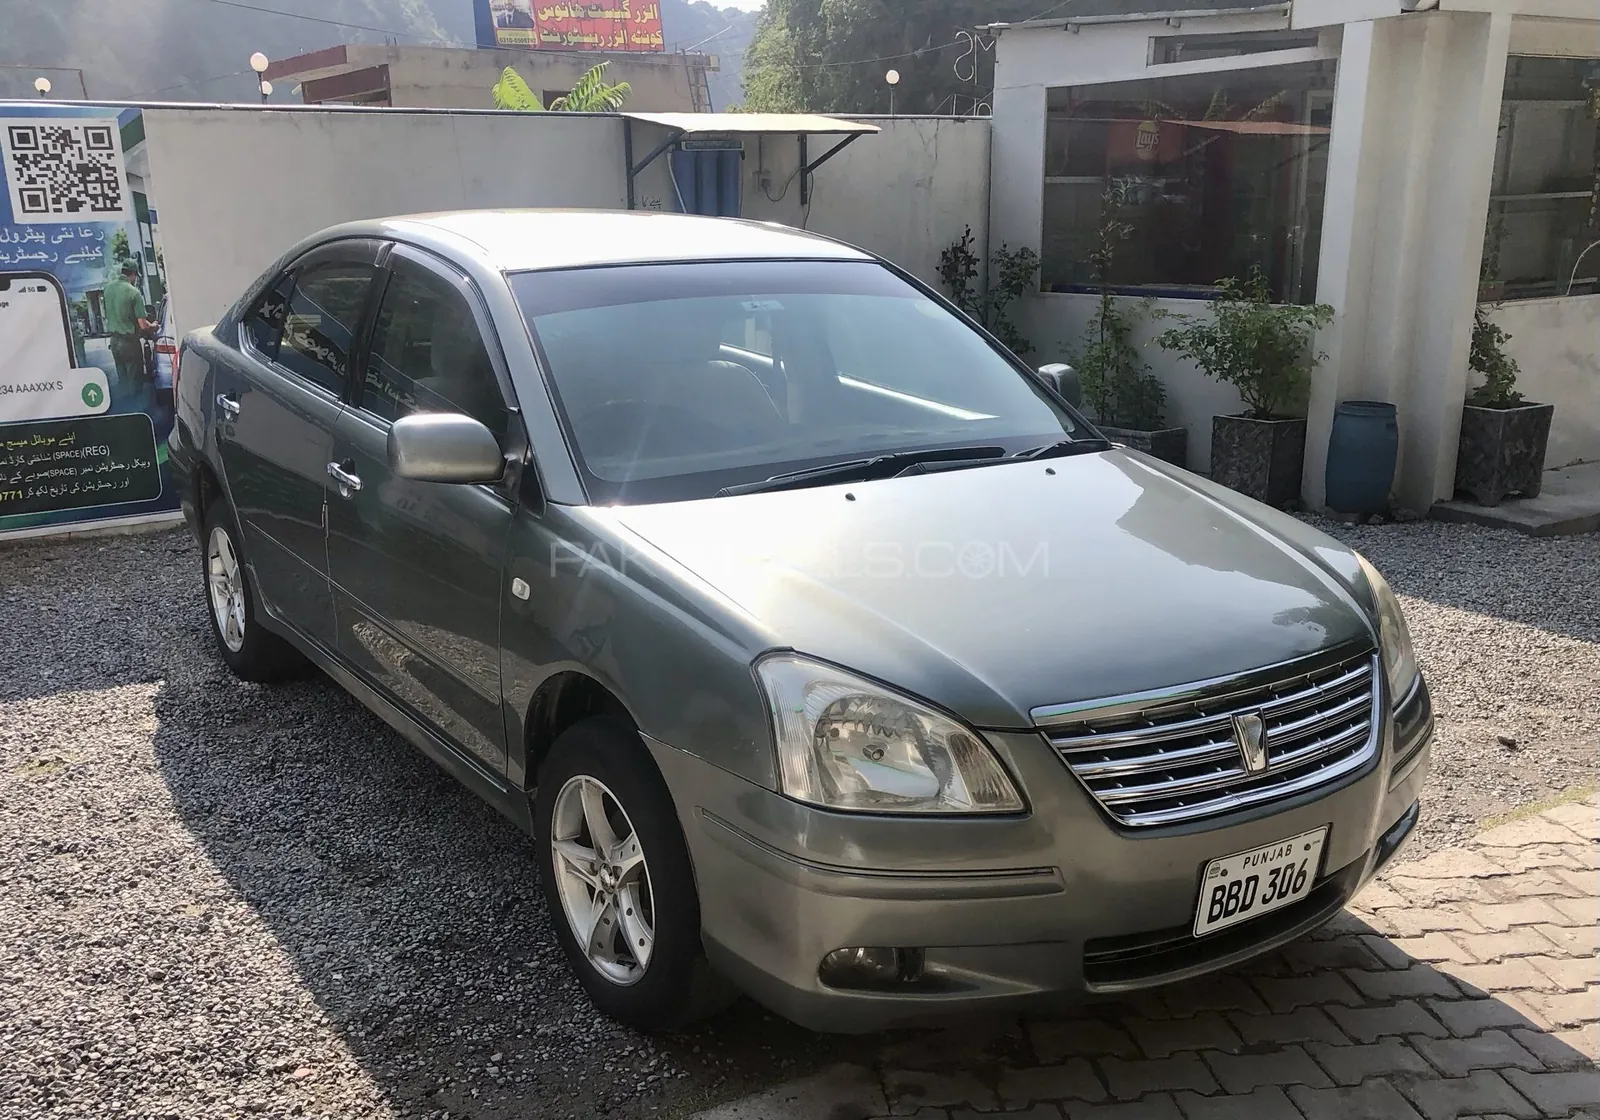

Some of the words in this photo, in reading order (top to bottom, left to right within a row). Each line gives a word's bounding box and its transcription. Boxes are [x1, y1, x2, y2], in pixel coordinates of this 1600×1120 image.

[0, 384, 13, 394] 34
[16, 382, 55, 393] AAAXXX
[56, 380, 64, 391] S
[1242, 844, 1293, 869] PUNJAB
[1207, 874, 1259, 924] BBD
[1261, 858, 1308, 905] 306
